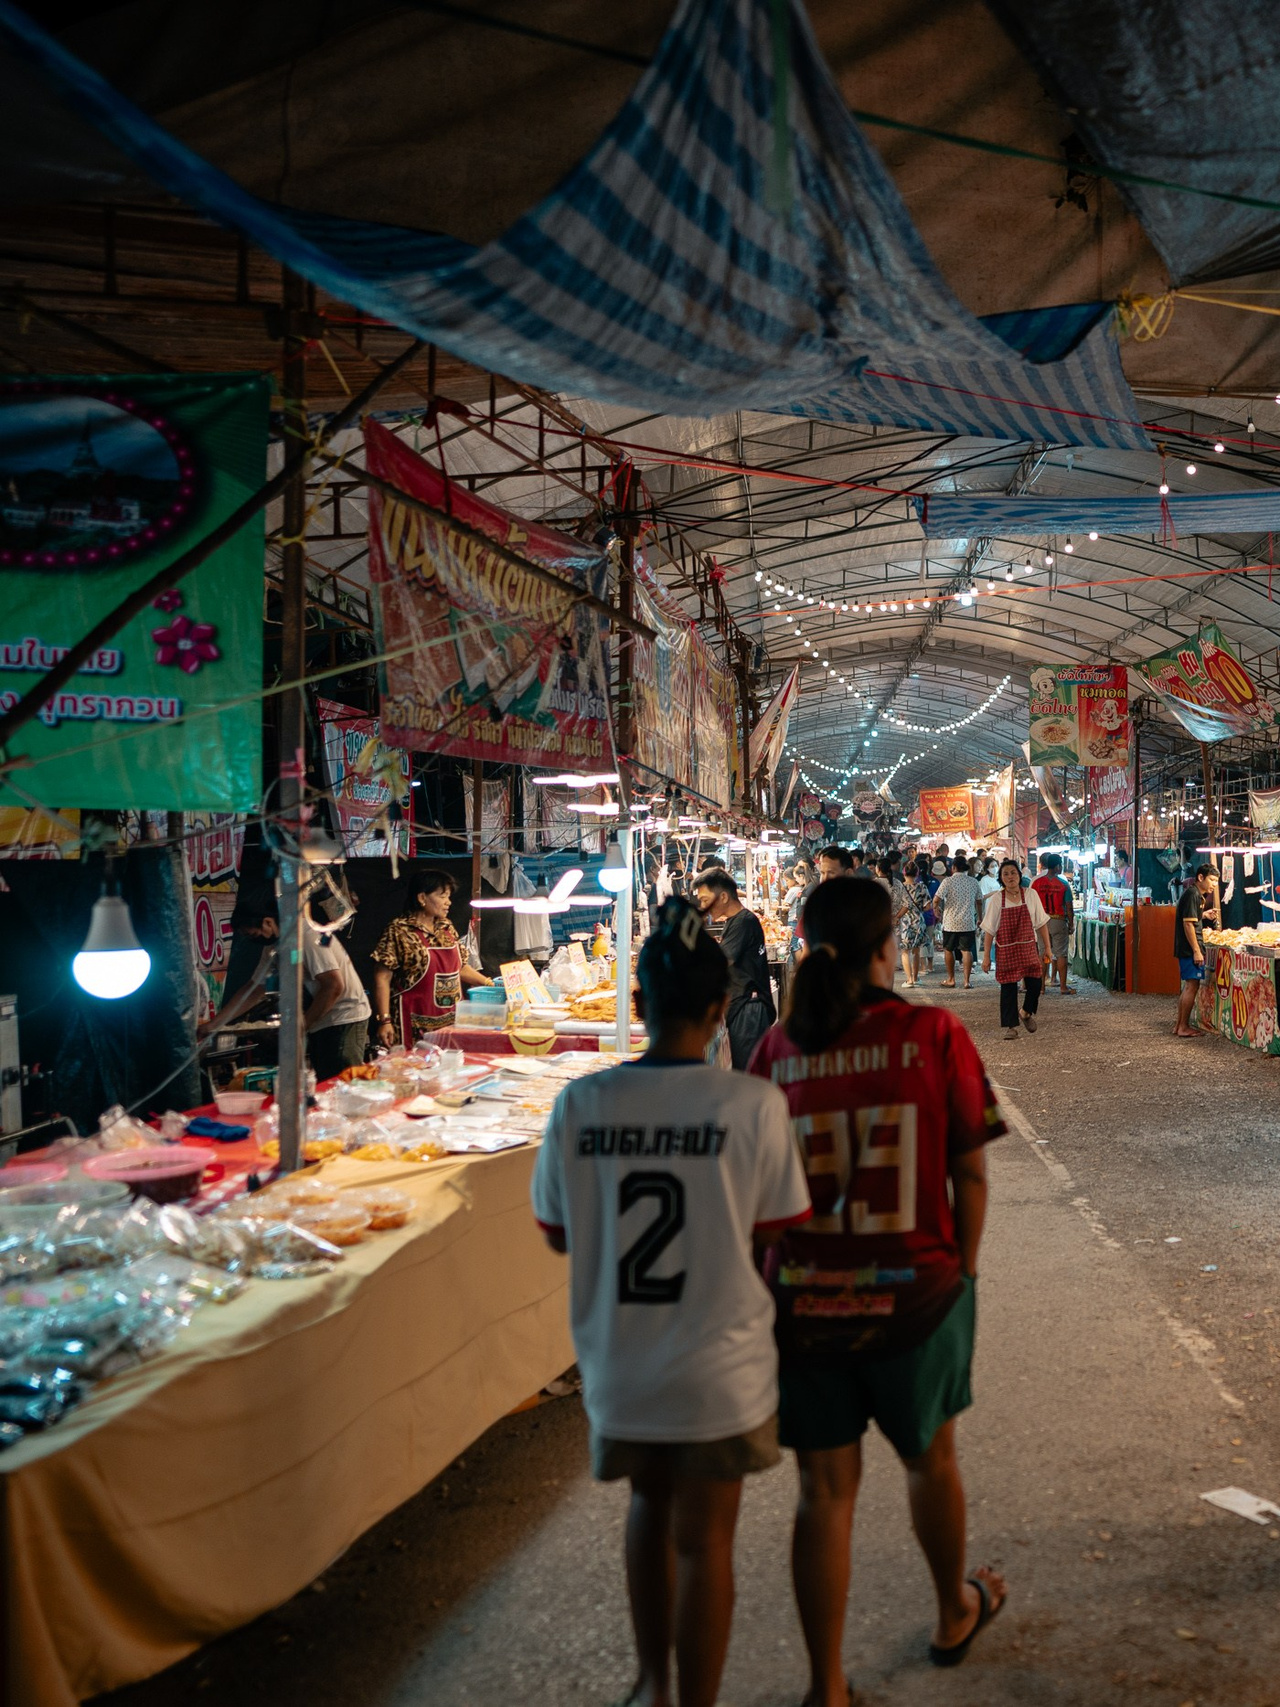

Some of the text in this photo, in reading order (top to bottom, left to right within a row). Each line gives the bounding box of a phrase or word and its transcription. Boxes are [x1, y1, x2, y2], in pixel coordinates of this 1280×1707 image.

[1208, 656, 1253, 703] 10
[1233, 988, 1247, 1028] 10
[901, 1041, 925, 1069] P.
[618, 1171, 687, 1305] 2
